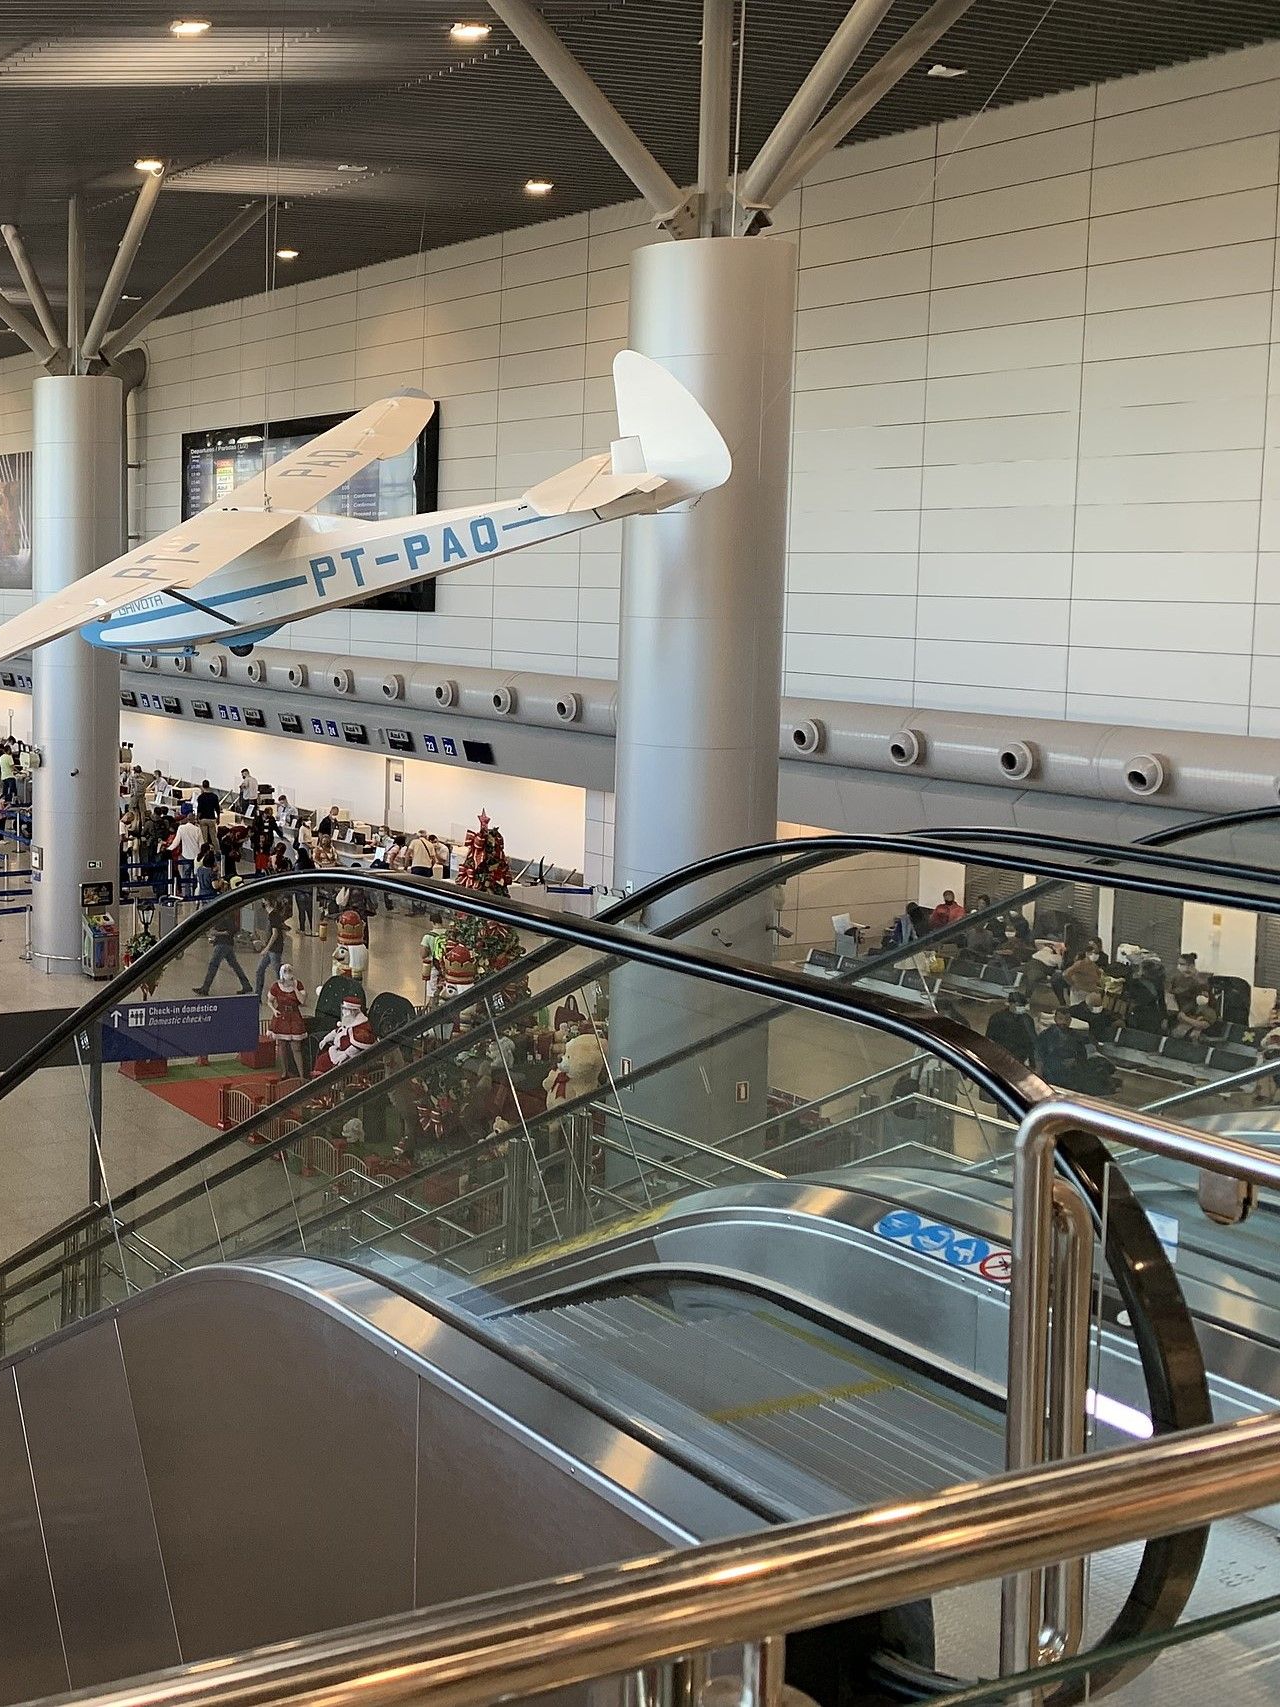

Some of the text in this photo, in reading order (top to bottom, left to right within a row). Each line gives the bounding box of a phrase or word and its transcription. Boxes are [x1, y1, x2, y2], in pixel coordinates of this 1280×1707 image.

[309, 516, 500, 598] PT-PAQ
[426, 741, 436, 752] 23
[445, 744, 455, 755] 22
[148, 1004, 218, 1015] Check-in doméstico
[148, 1015, 212, 1026] Domestic check-in
